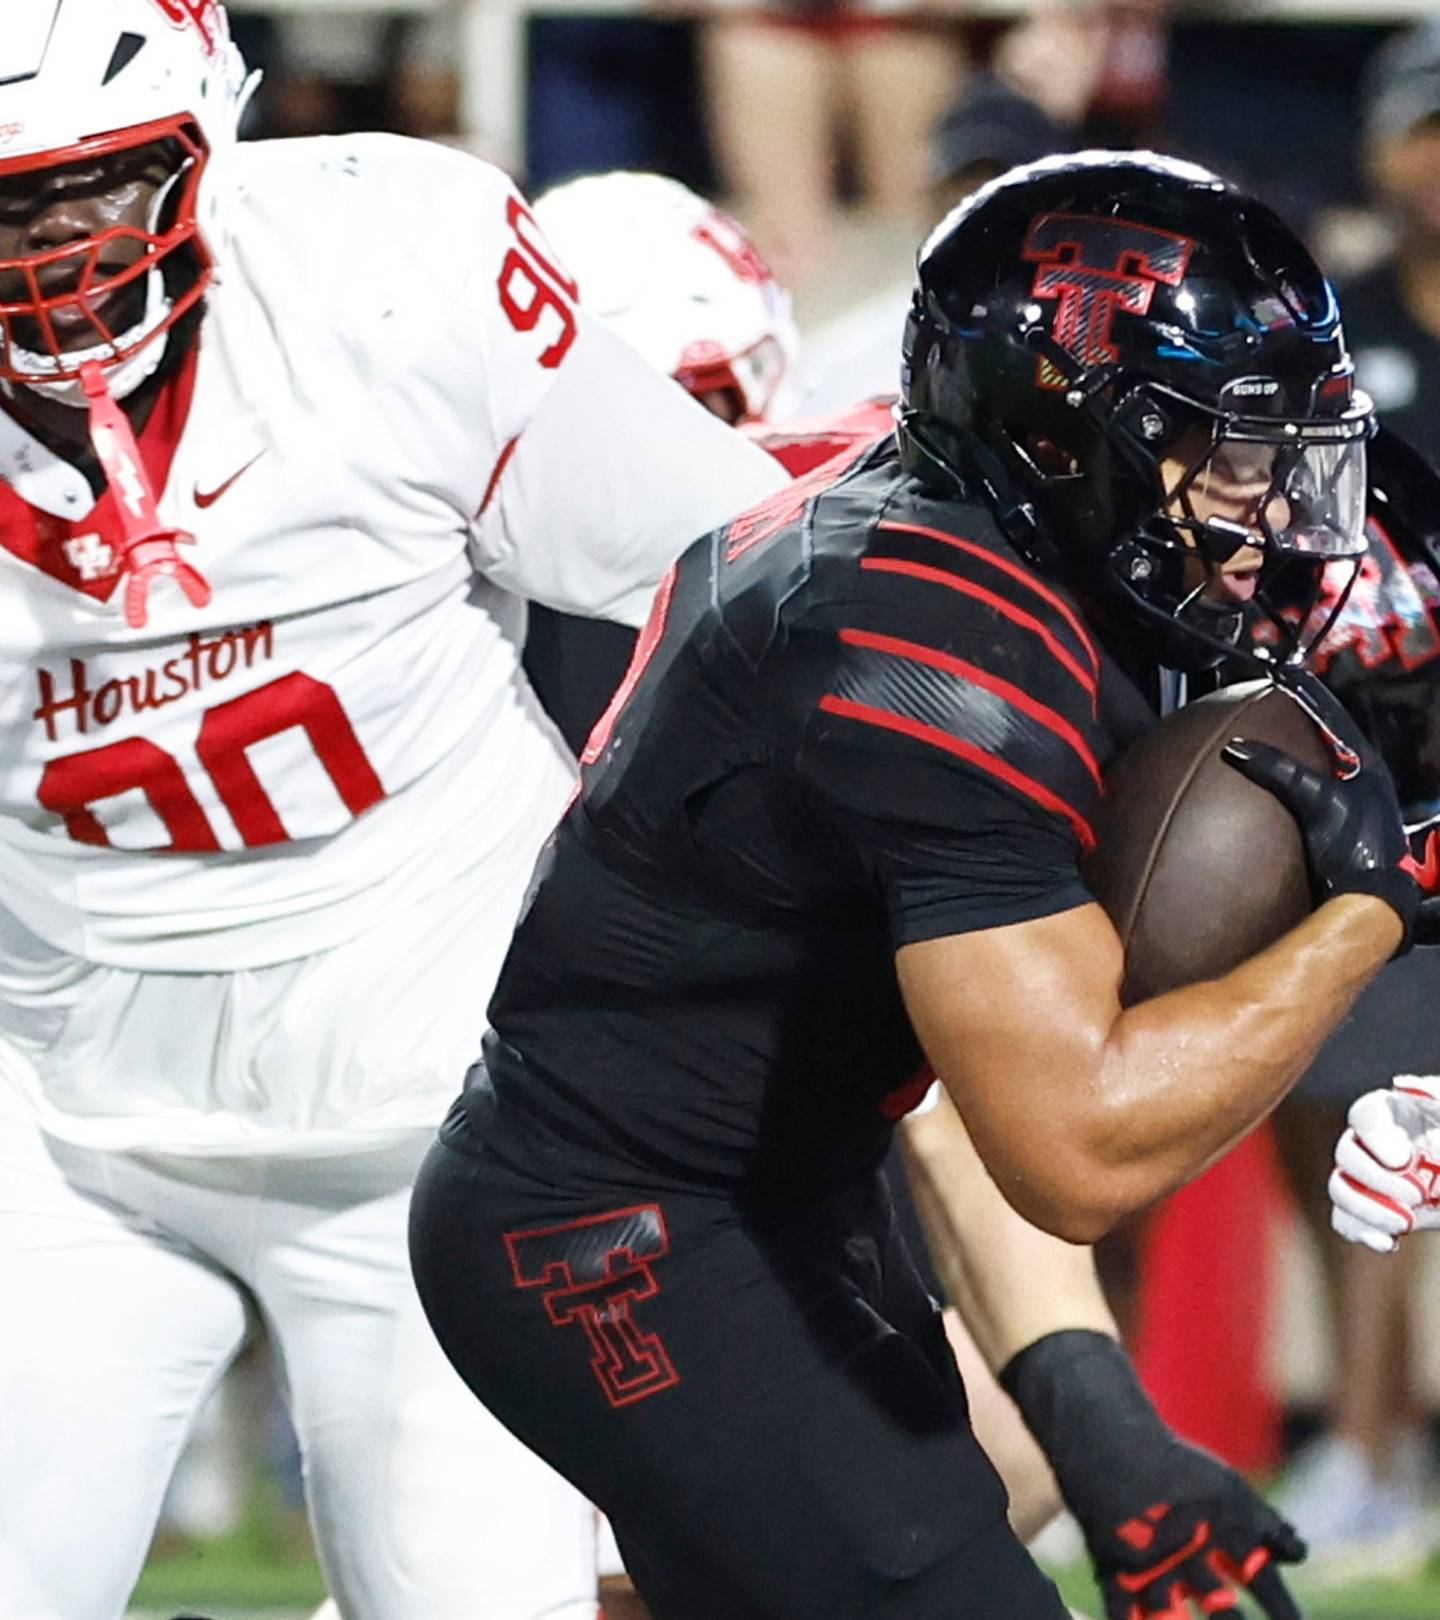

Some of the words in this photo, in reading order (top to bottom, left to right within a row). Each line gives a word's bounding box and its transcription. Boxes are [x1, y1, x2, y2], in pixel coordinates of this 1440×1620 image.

[497, 194, 580, 369] 90
[1232, 384, 1262, 396] GUNS
[1263, 382, 1279, 395] UP
[33, 620, 273, 741] Houston
